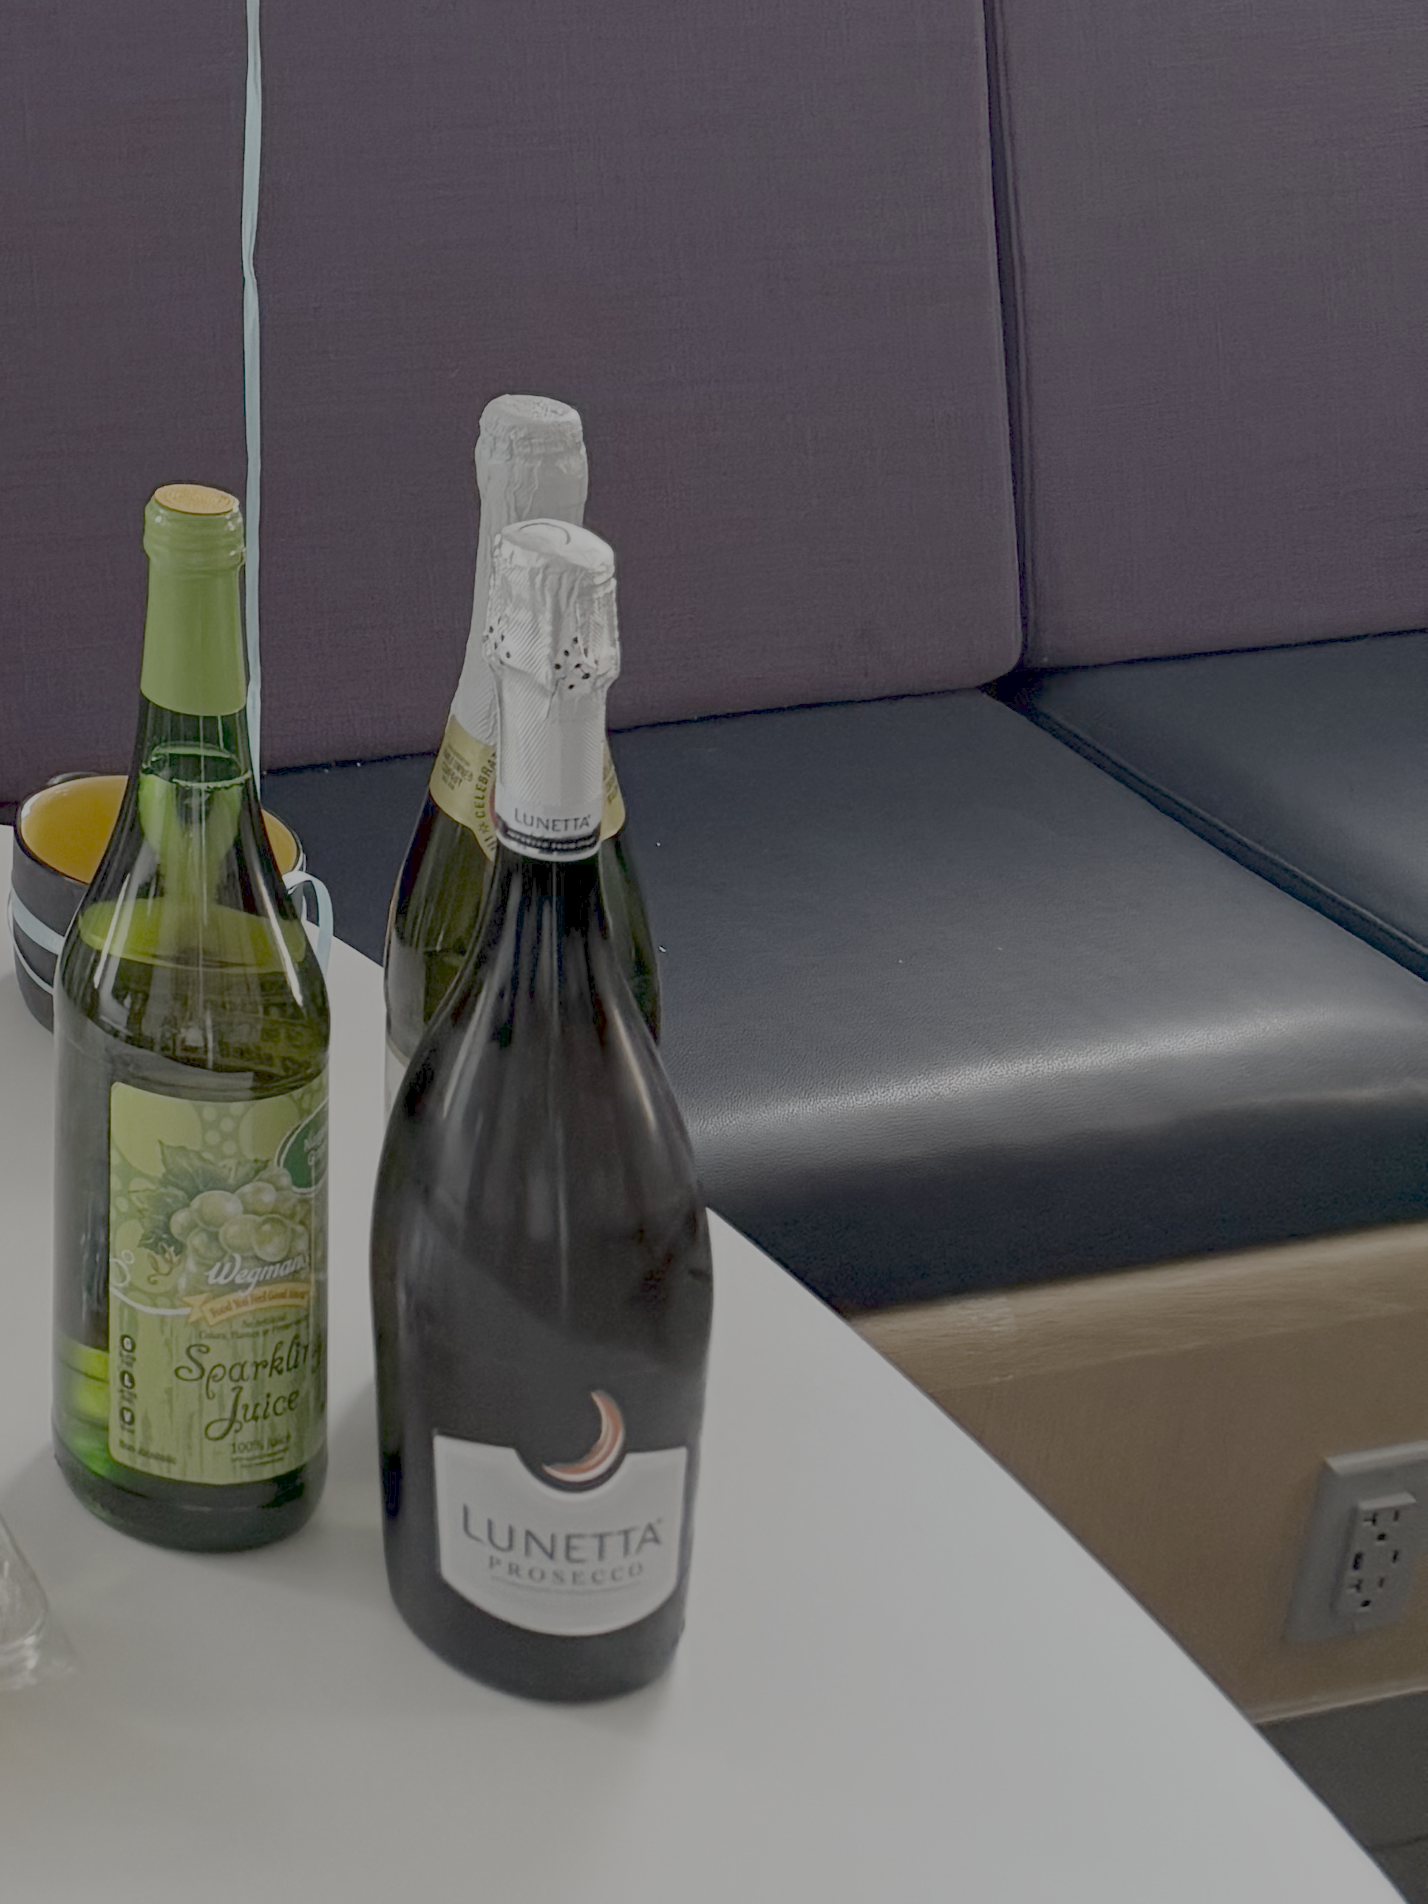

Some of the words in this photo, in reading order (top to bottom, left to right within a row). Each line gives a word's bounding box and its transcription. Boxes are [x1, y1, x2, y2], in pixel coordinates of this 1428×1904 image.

[515, 807, 590, 832] LUNETTA
[205, 1386, 300, 1441] Juice
[462, 1503, 662, 1564] LUNETTA
[489, 1555, 645, 1585] PROSECCO
